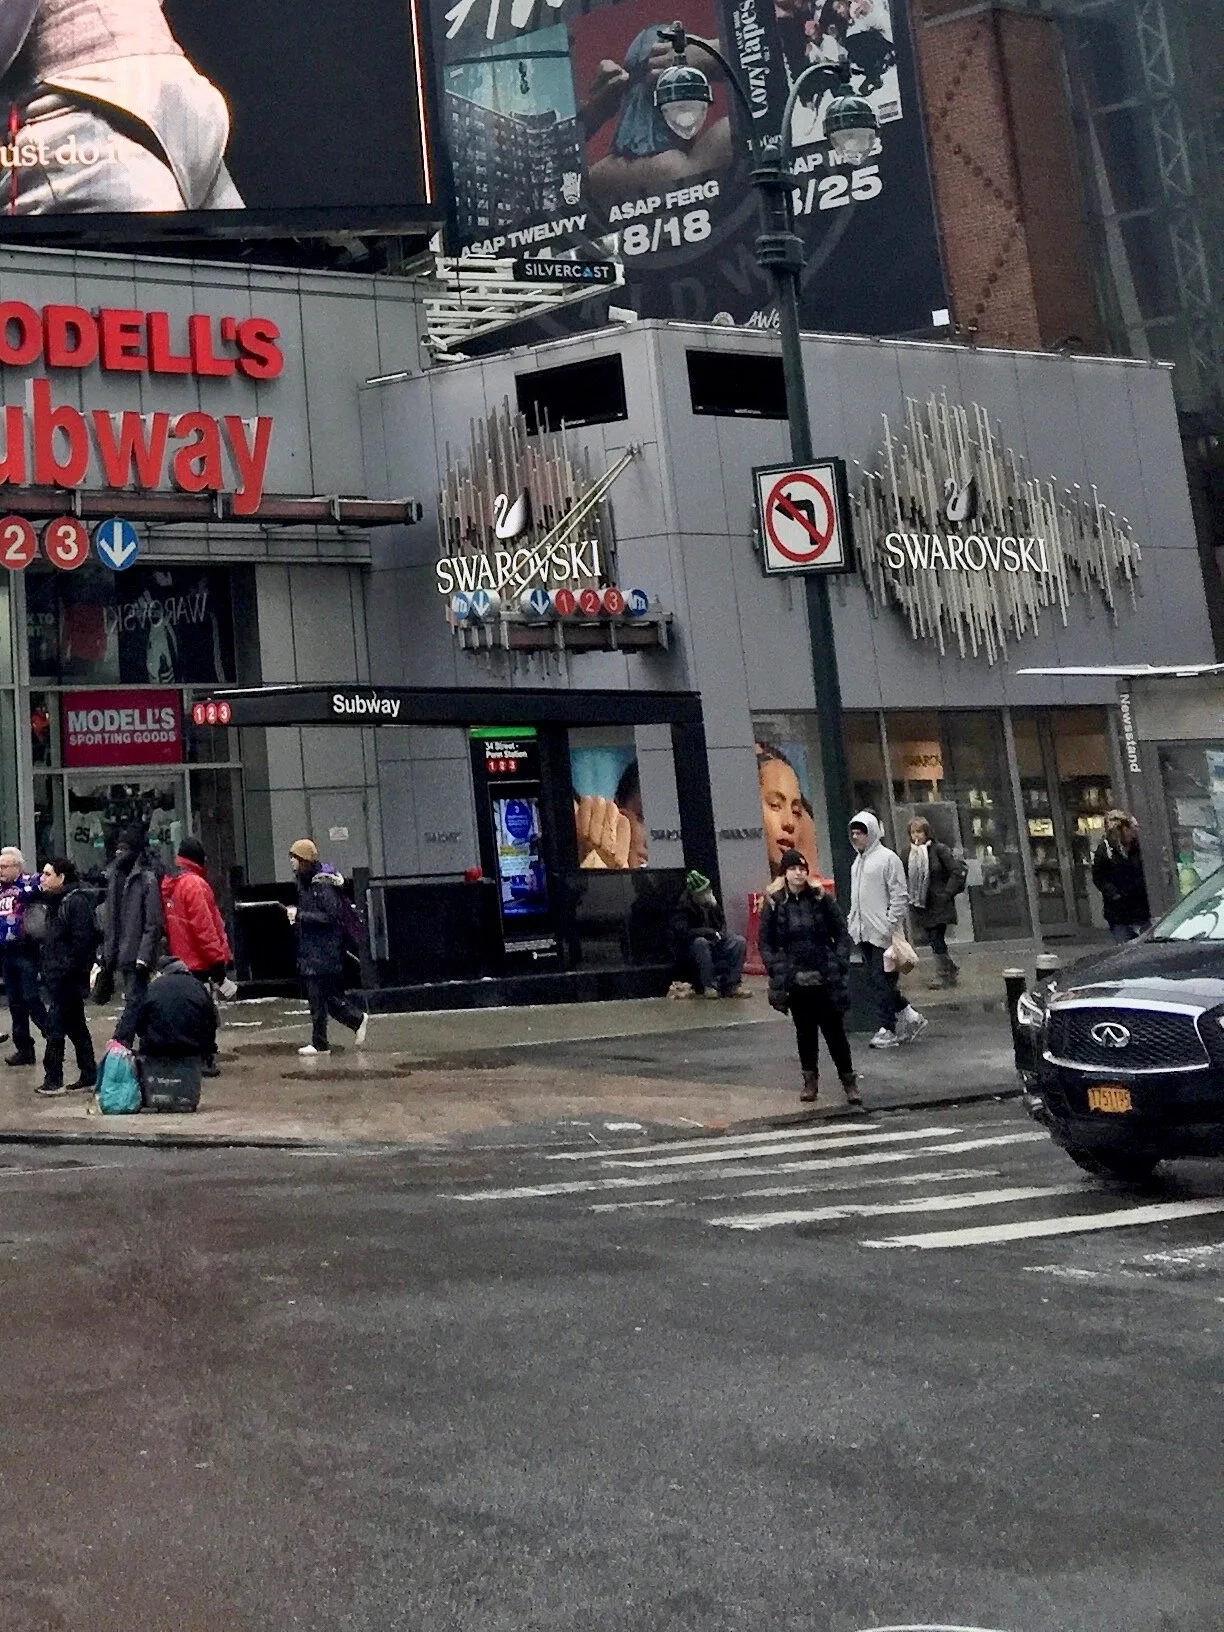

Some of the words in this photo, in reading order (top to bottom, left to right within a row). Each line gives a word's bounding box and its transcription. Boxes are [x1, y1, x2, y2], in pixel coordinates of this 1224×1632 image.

[54, 134, 100, 165] do
[829, 137, 883, 167] MB
[609, 195, 661, 223] ASAP
[665, 180, 720, 209] FERG
[623, 209, 712, 256] 8/18
[3, 528, 27, 561] 2
[56, 528, 79, 561] 3
[885, 532, 1050, 573] SWAROVSKI
[436, 539, 602, 595] SWAROVSKI
[560, 595, 569, 613] 1
[585, 595, 595, 613] 2
[609, 594, 619, 611] 3
[68, 706, 176, 733] MODELL'S
[208, 707, 215, 720] 2
[221, 706, 228, 720] 3
[332, 693, 401, 717] Subway
[69, 732, 131, 746] SPORTING
[133, 730, 176, 744] GOODS
[1119, 693, 1142, 773] Newsstand
